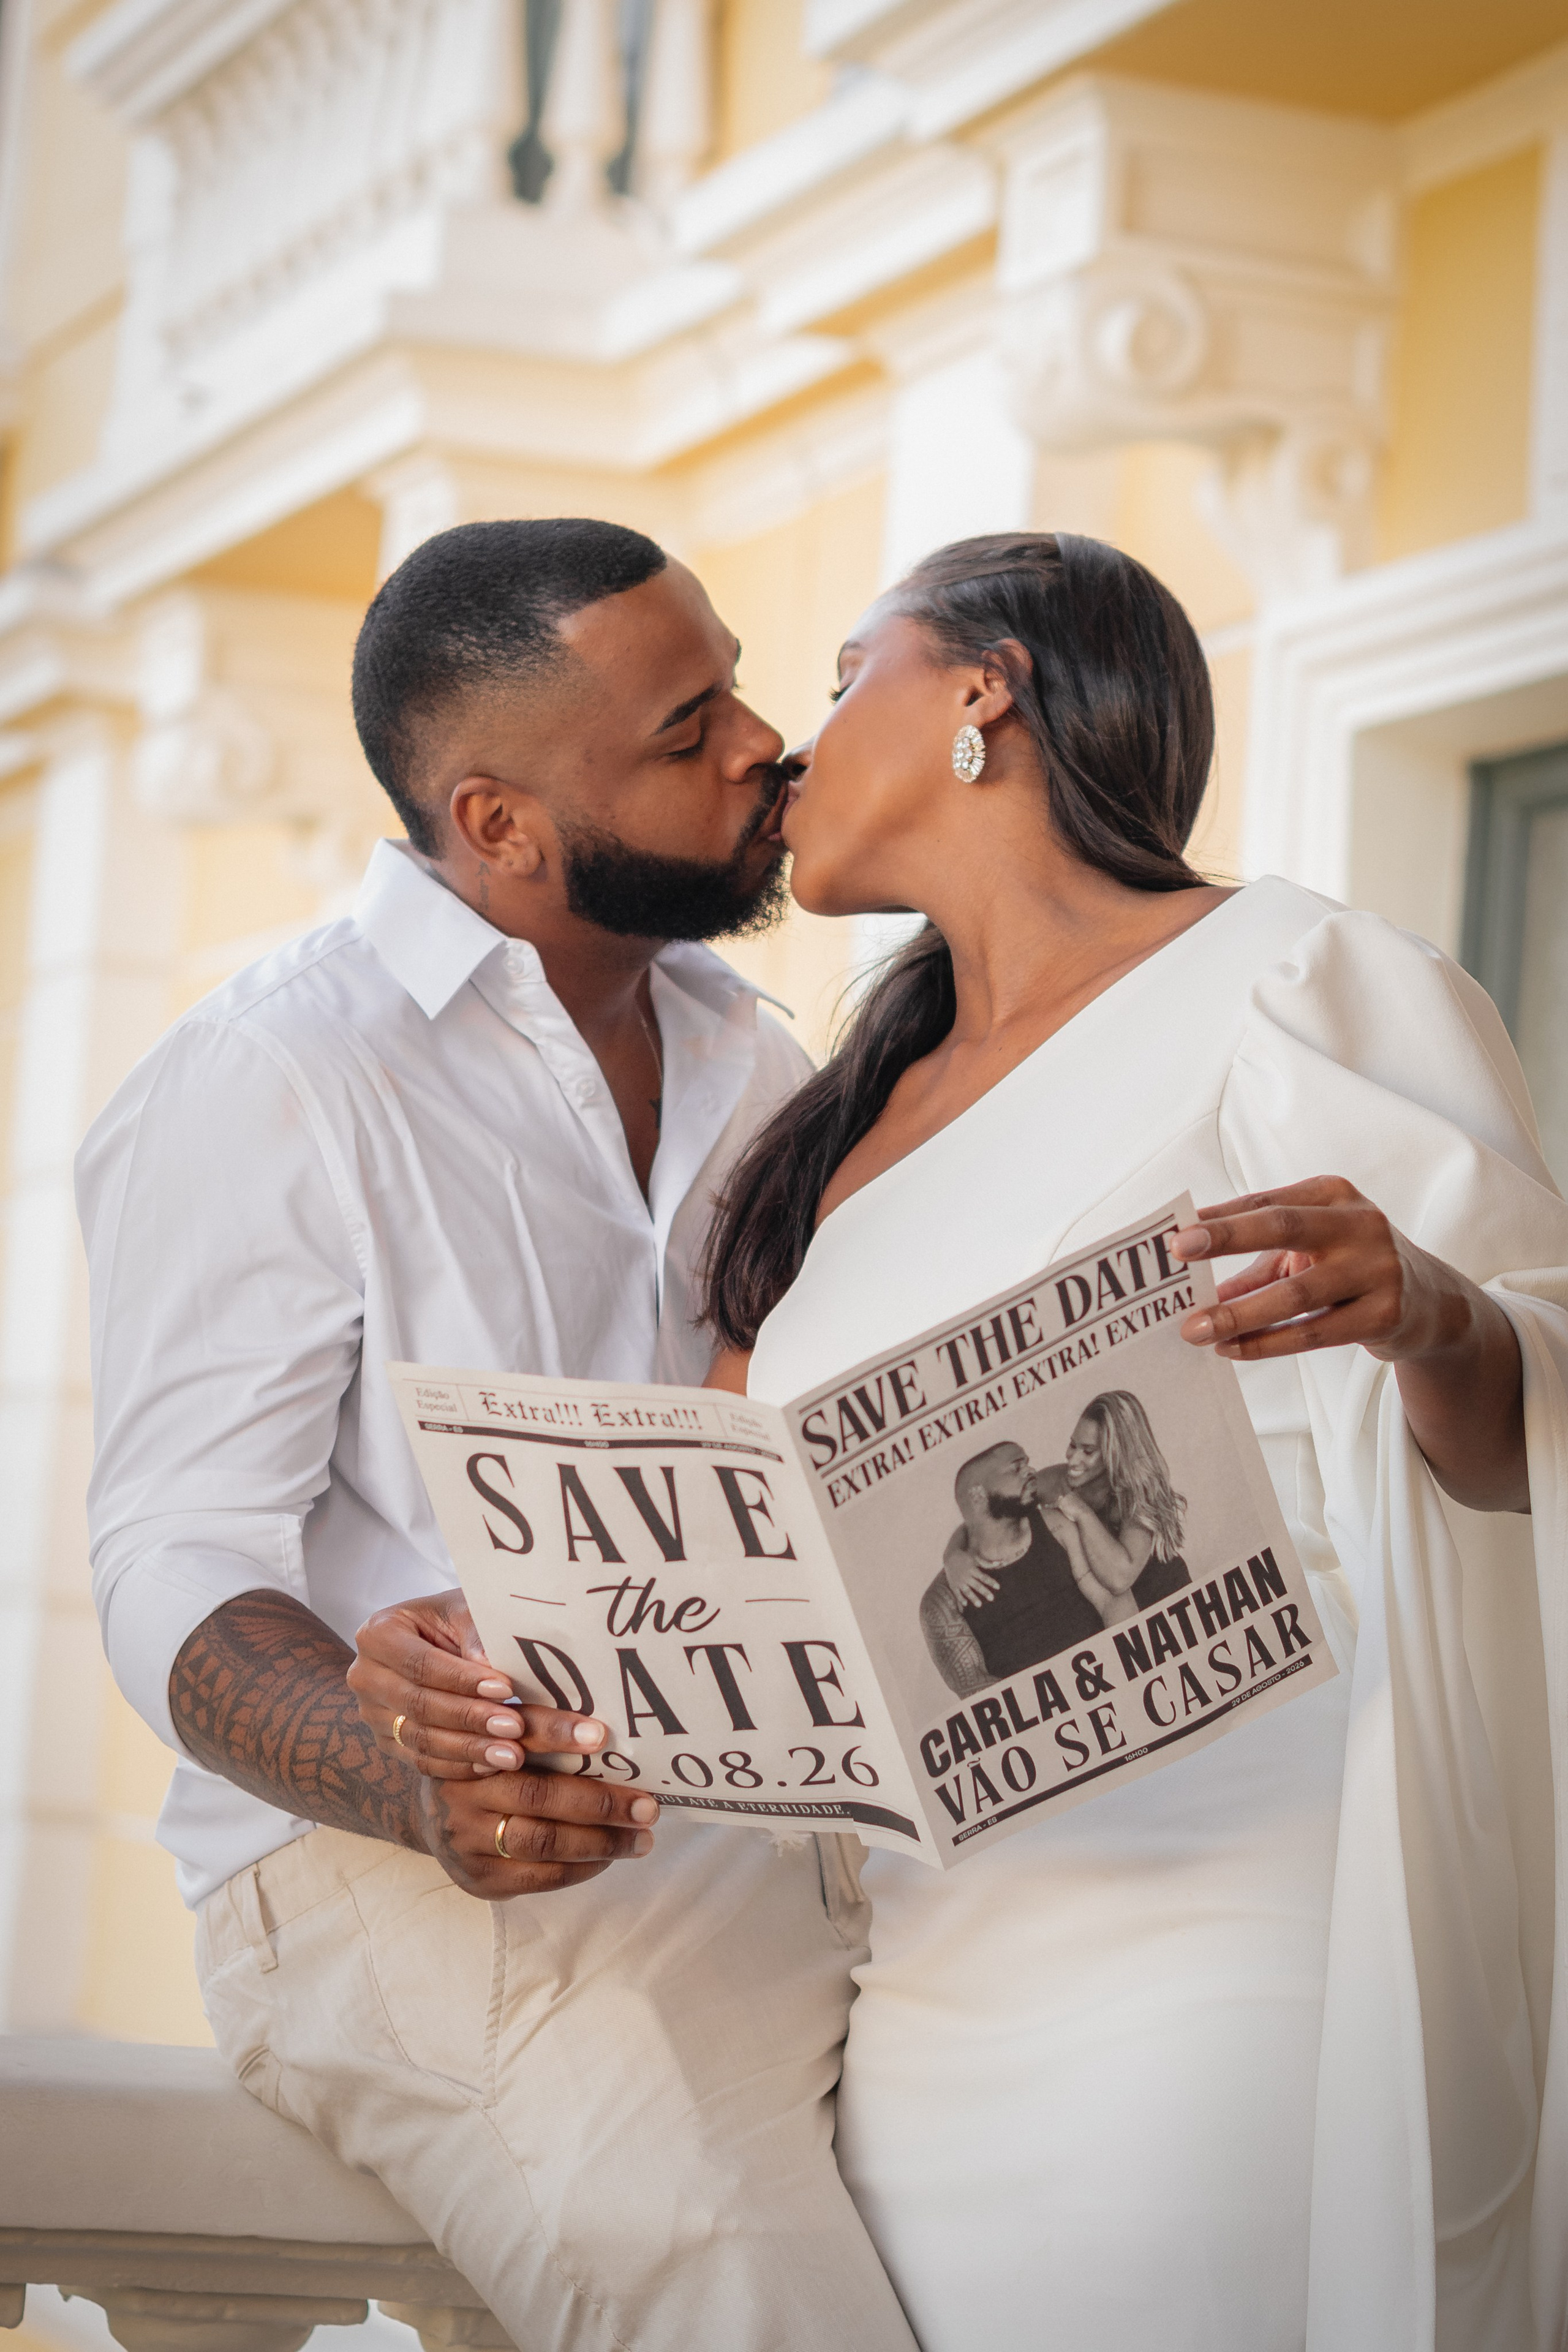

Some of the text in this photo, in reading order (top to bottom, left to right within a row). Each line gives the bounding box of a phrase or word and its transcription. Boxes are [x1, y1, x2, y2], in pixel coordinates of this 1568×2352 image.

[801, 1224, 1189, 1471] SAVE THE DATE
[479, 1392, 583, 1427] Extra!!!
[590, 1403, 703, 1430] Extra!!!
[827, 1287, 1196, 1510] EXTRA! EXTRA! EXTRA! EXTRA!
[466, 1452, 798, 1563] SAVE
[586, 1576, 721, 1637] the
[512, 1635, 867, 1738] DATE
[919, 1546, 1288, 1779] CARLA & NATHAN
[1231, 1697, 1241, 1707] 29
[1241, 1692, 1252, 1701] DE
[1252, 1673, 1281, 1695] AGOSTO
[1286, 1660, 1305, 1675] 2026
[933, 1603, 1313, 1826] VÃO SE CASAR
[1124, 1747, 1148, 1762] 16H00
[687, 1796, 718, 1808] ATÉ
[722, 1801, 734, 1810] A
[736, 1802, 851, 1815] ETERNIDADE.
[958, 1825, 983, 1841] SERRA
